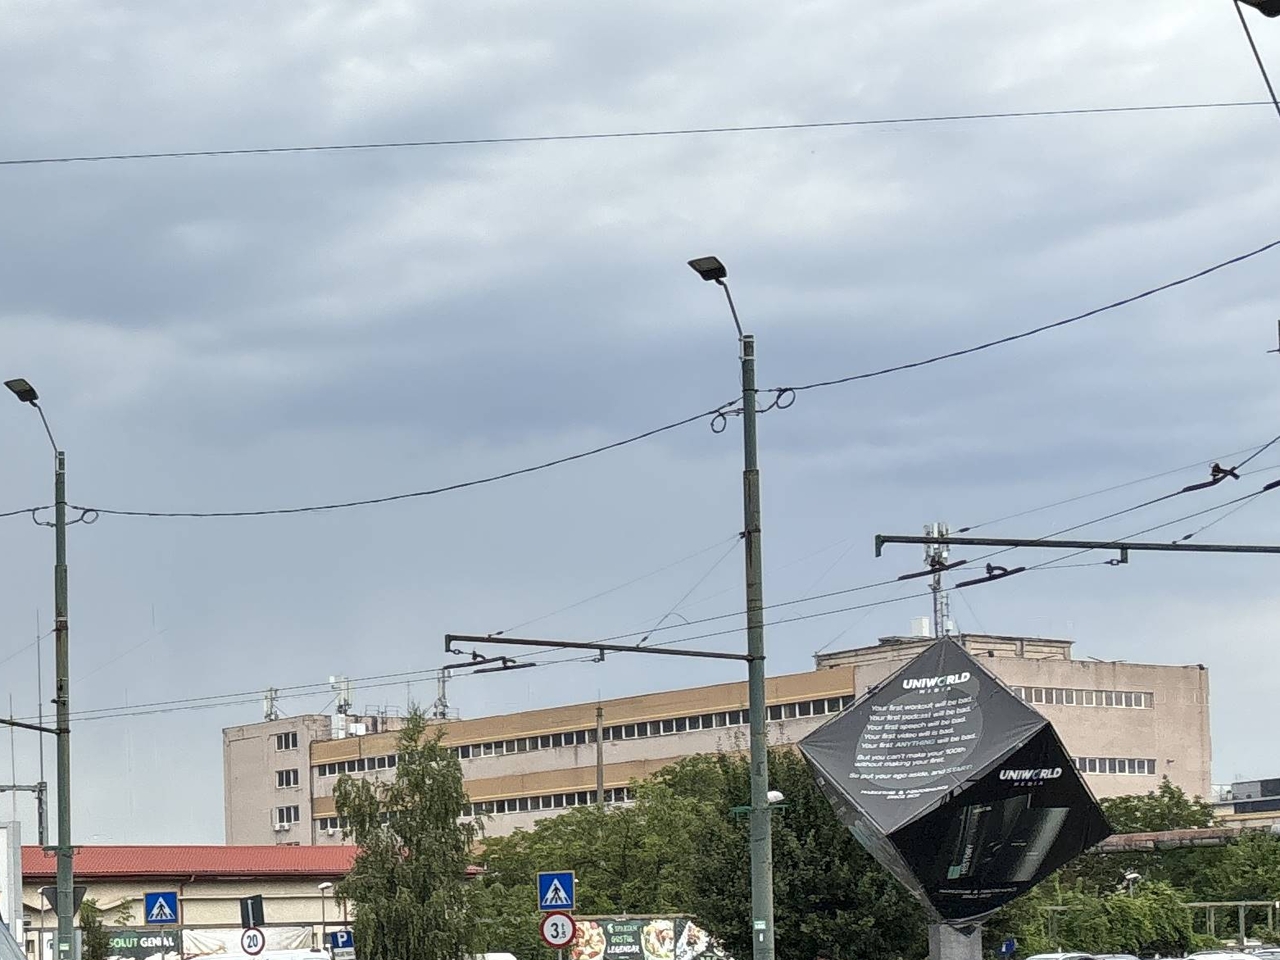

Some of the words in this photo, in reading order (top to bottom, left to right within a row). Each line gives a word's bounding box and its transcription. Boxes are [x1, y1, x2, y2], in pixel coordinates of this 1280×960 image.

[902, 672, 970, 689] UNIWORLD
[904, 702, 934, 710] workout
[902, 712, 931, 721] podcast
[900, 722, 926, 730] speech
[894, 738, 936, 748] ANYTHING
[927, 750, 944, 758] your
[884, 760, 912, 768] making
[930, 768, 946, 776] and
[999, 768, 1062, 780] UNIWORLD
[550, 922, 560, 938] 3
[246, 934, 258, 948] 20
[337, 932, 348, 948] P
